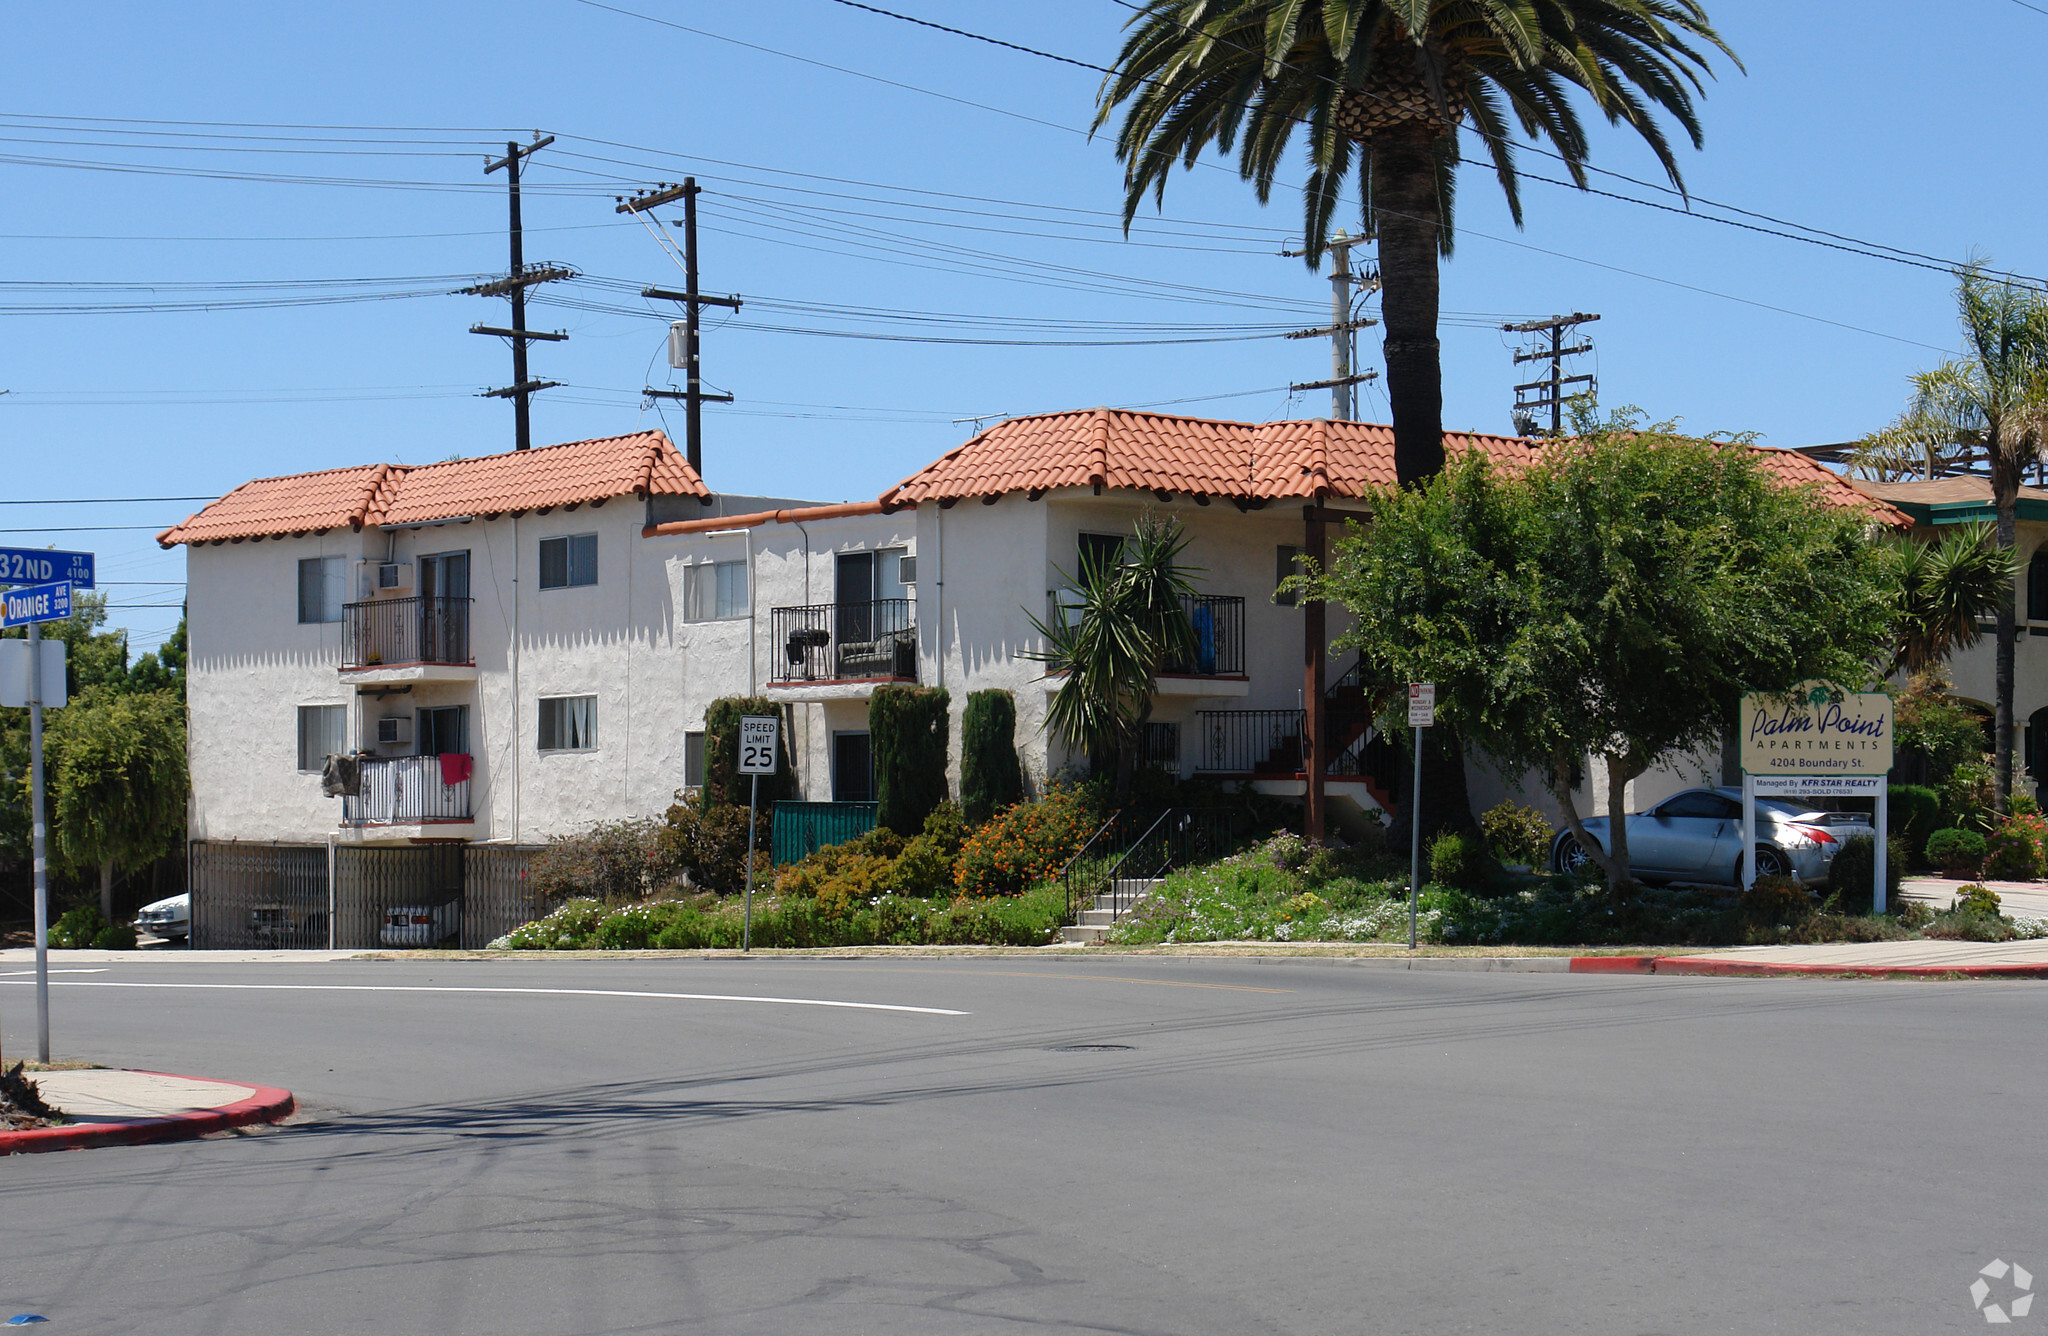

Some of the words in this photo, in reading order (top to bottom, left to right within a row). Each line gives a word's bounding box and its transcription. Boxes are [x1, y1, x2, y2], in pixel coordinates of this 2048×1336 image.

[0, 553, 53, 580] 32ND
[72, 555, 83, 567] ST
[66, 567, 89, 579] 4100
[55, 585, 67, 597] AVE
[8, 594, 49, 620] ORANGE
[54, 597, 68, 610] 3200
[1411, 686, 1419, 696] NO
[744, 723, 775, 732] SPEED
[1750, 704, 1814, 742] Palm
[1820, 704, 1884, 738] Point
[746, 735, 771, 744] LIMIT
[1756, 740, 1878, 750] APARTMENTS
[744, 746, 772, 767] 25
[1770, 758, 1796, 767] 4204
[1799, 758, 1848, 770] Boundary
[1851, 758, 1865, 768] St.
[1756, 779, 1787, 788] Managed
[1789, 779, 1799, 788] By
[1844, 779, 1879, 787] REALTY
